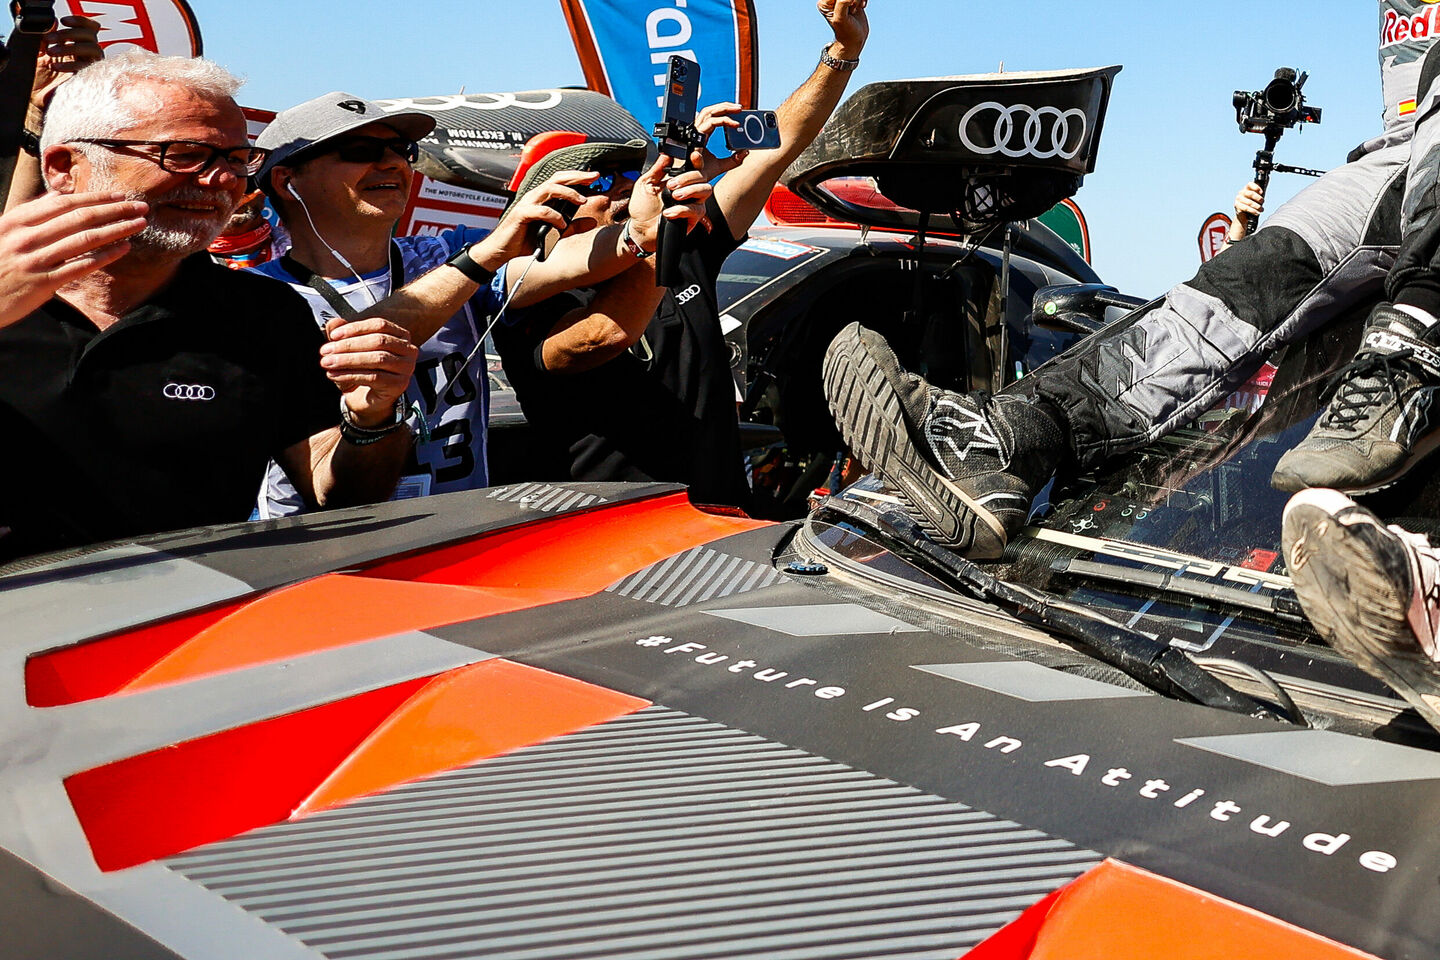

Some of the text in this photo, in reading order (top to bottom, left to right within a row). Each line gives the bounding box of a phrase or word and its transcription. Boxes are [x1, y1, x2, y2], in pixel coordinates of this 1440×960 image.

[1381, 7, 1435, 46] Red
[447, 128, 505, 141] EKSTROM
[424, 187, 438, 195] THE
[438, 189, 481, 202] MOTORCYCLE
[635, 635, 1398, 874] #Future Is An Attitude
